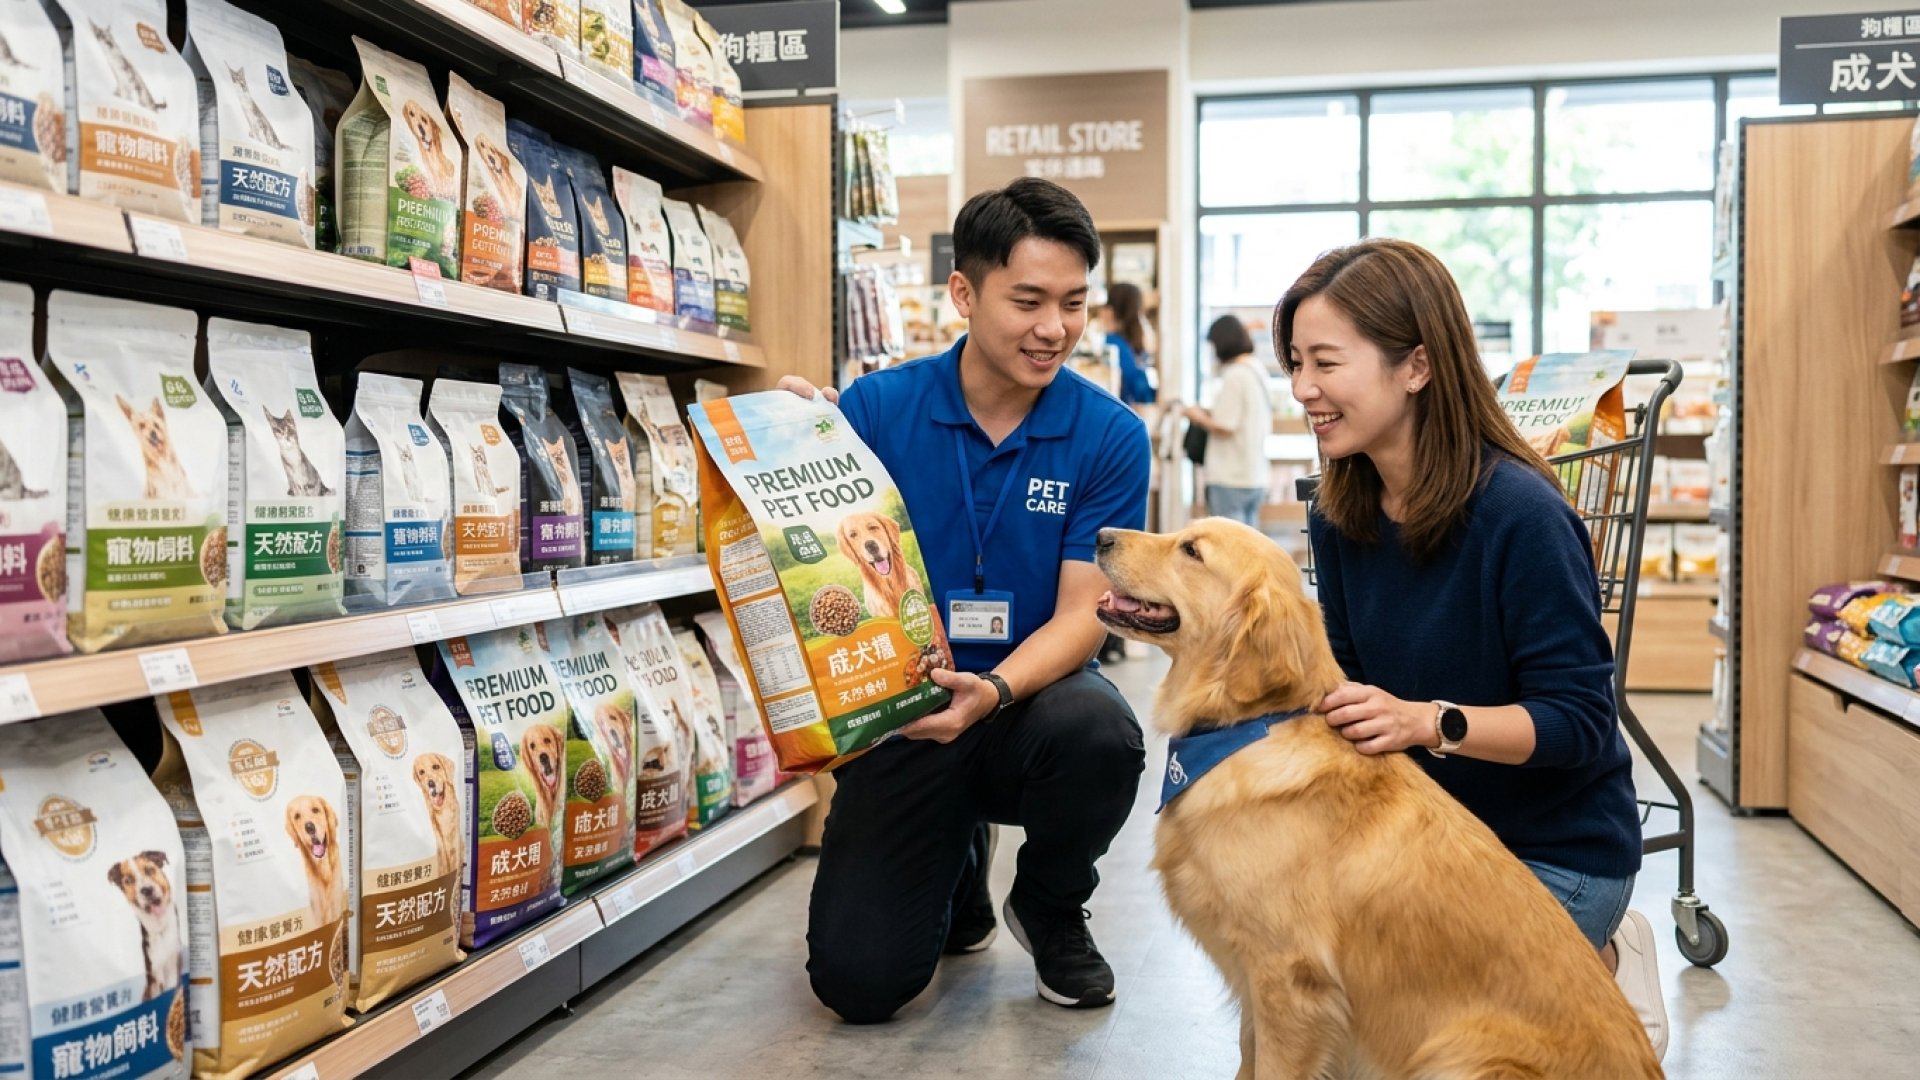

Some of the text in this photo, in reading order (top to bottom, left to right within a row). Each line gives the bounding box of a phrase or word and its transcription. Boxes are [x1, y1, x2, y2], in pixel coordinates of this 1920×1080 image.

[1830, 51, 1916, 92] 成犬
[985, 120, 1144, 155] RETAIL STORE
[744, 452, 861, 495] PREMIUM
[1028, 477, 1070, 500] PET
[761, 477, 874, 519] PET FOOD
[1026, 498, 1067, 515] CARE
[465, 664, 548, 700] PREMIUM
[505, 690, 556, 721] FOOD
[237, 940, 323, 993] 天然配方
